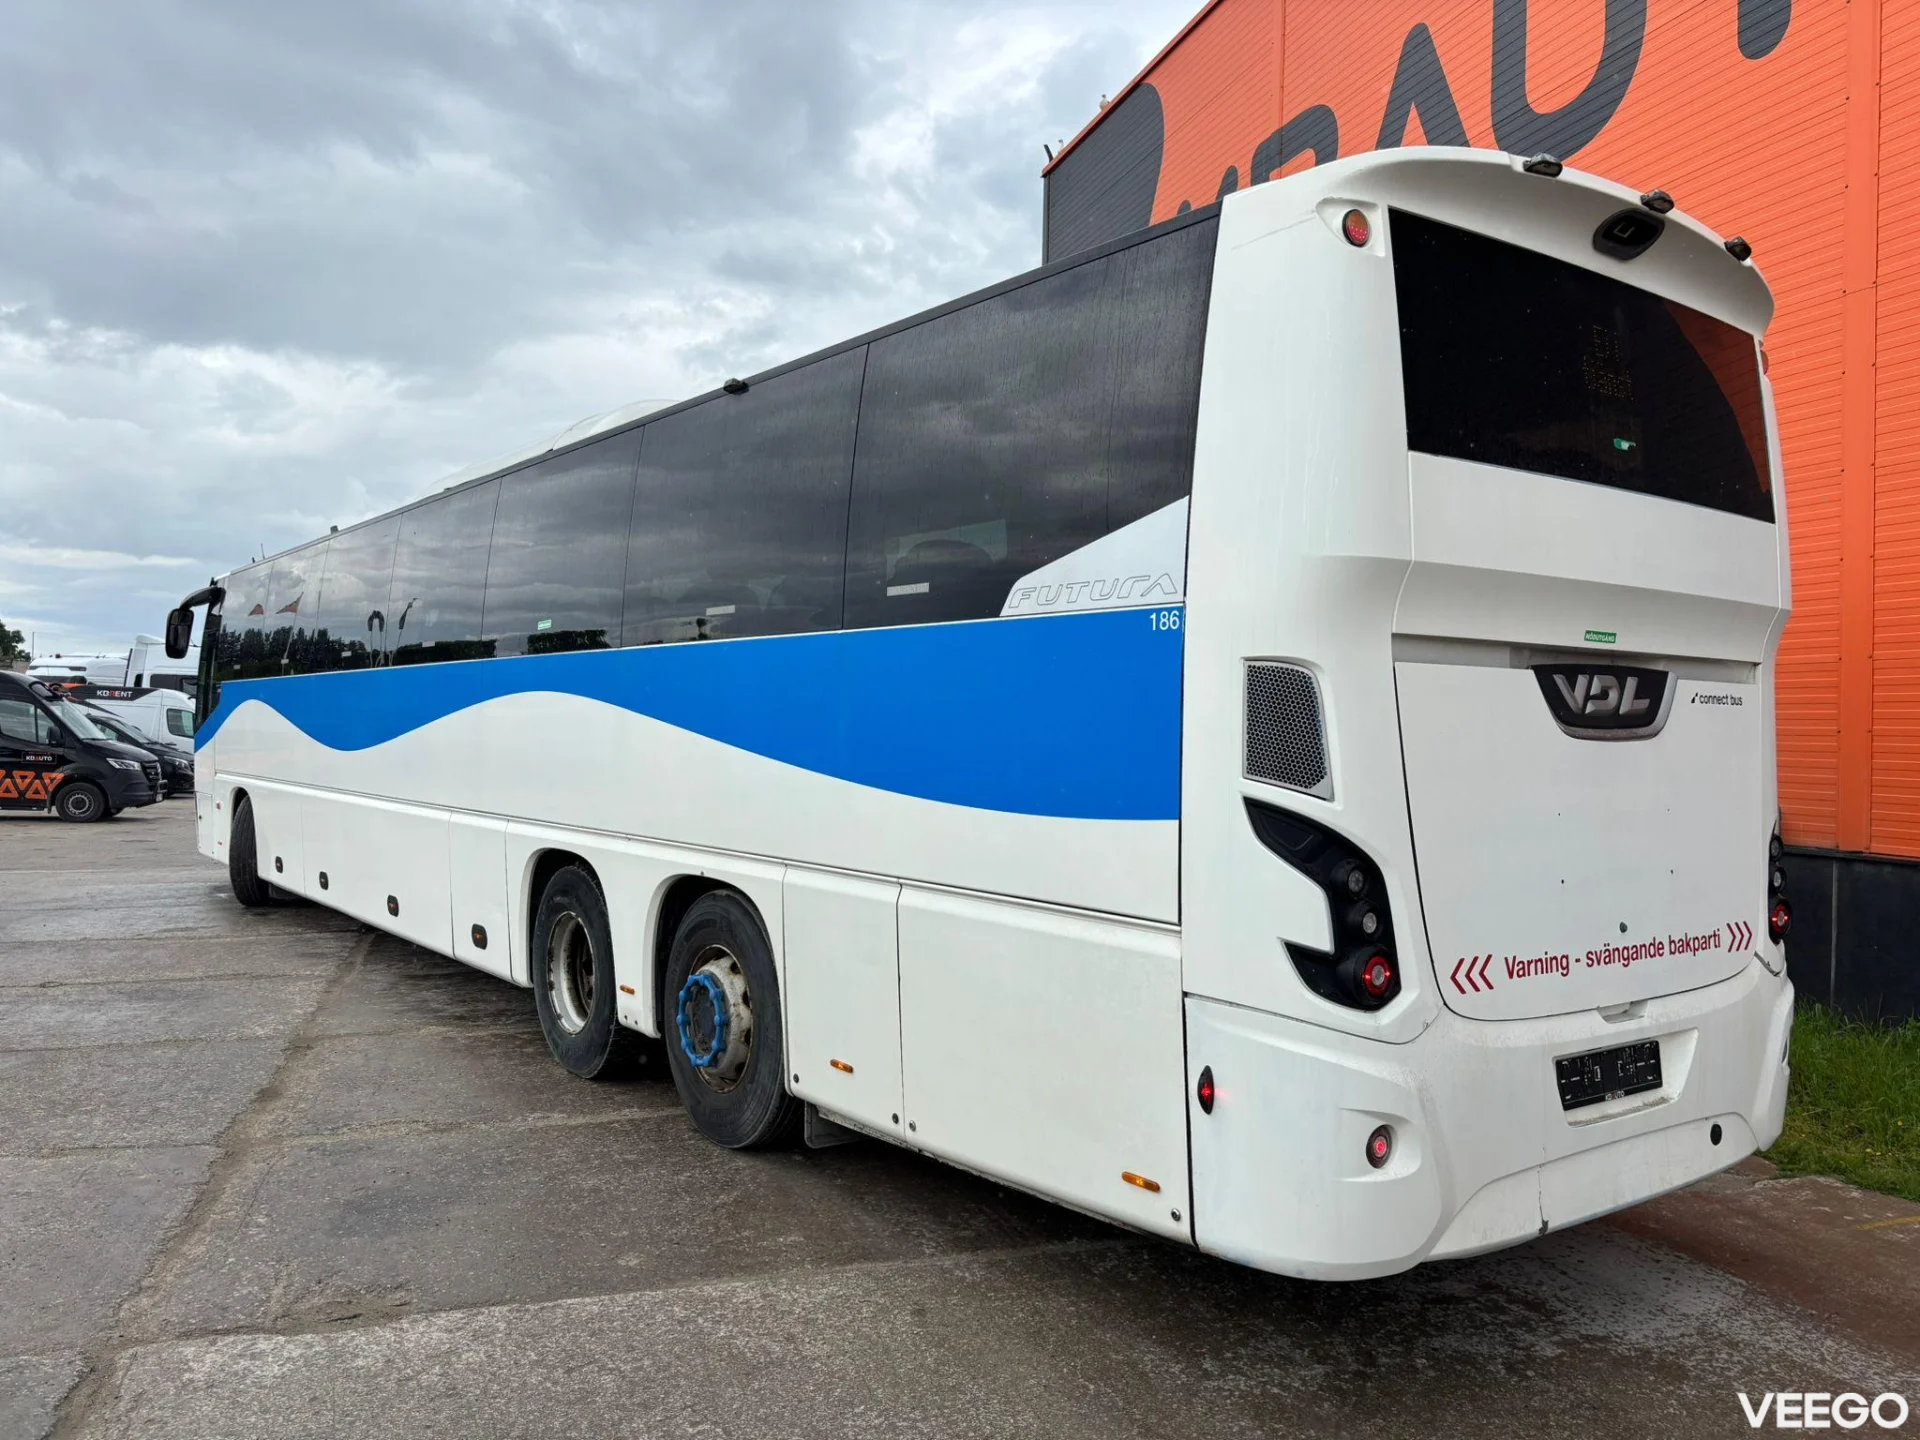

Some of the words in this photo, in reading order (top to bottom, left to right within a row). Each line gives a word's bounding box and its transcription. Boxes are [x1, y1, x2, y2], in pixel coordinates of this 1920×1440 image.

[1008, 573, 1178, 609] FUTURA
[1150, 610, 1180, 631] 186
[1552, 674, 1650, 715] VDL
[1699, 694, 1729, 705] connect
[1730, 694, 1743, 706] bus
[1504, 951, 1570, 980] Varning
[1586, 937, 1664, 968] svängande
[1668, 929, 1721, 955] bakparti
